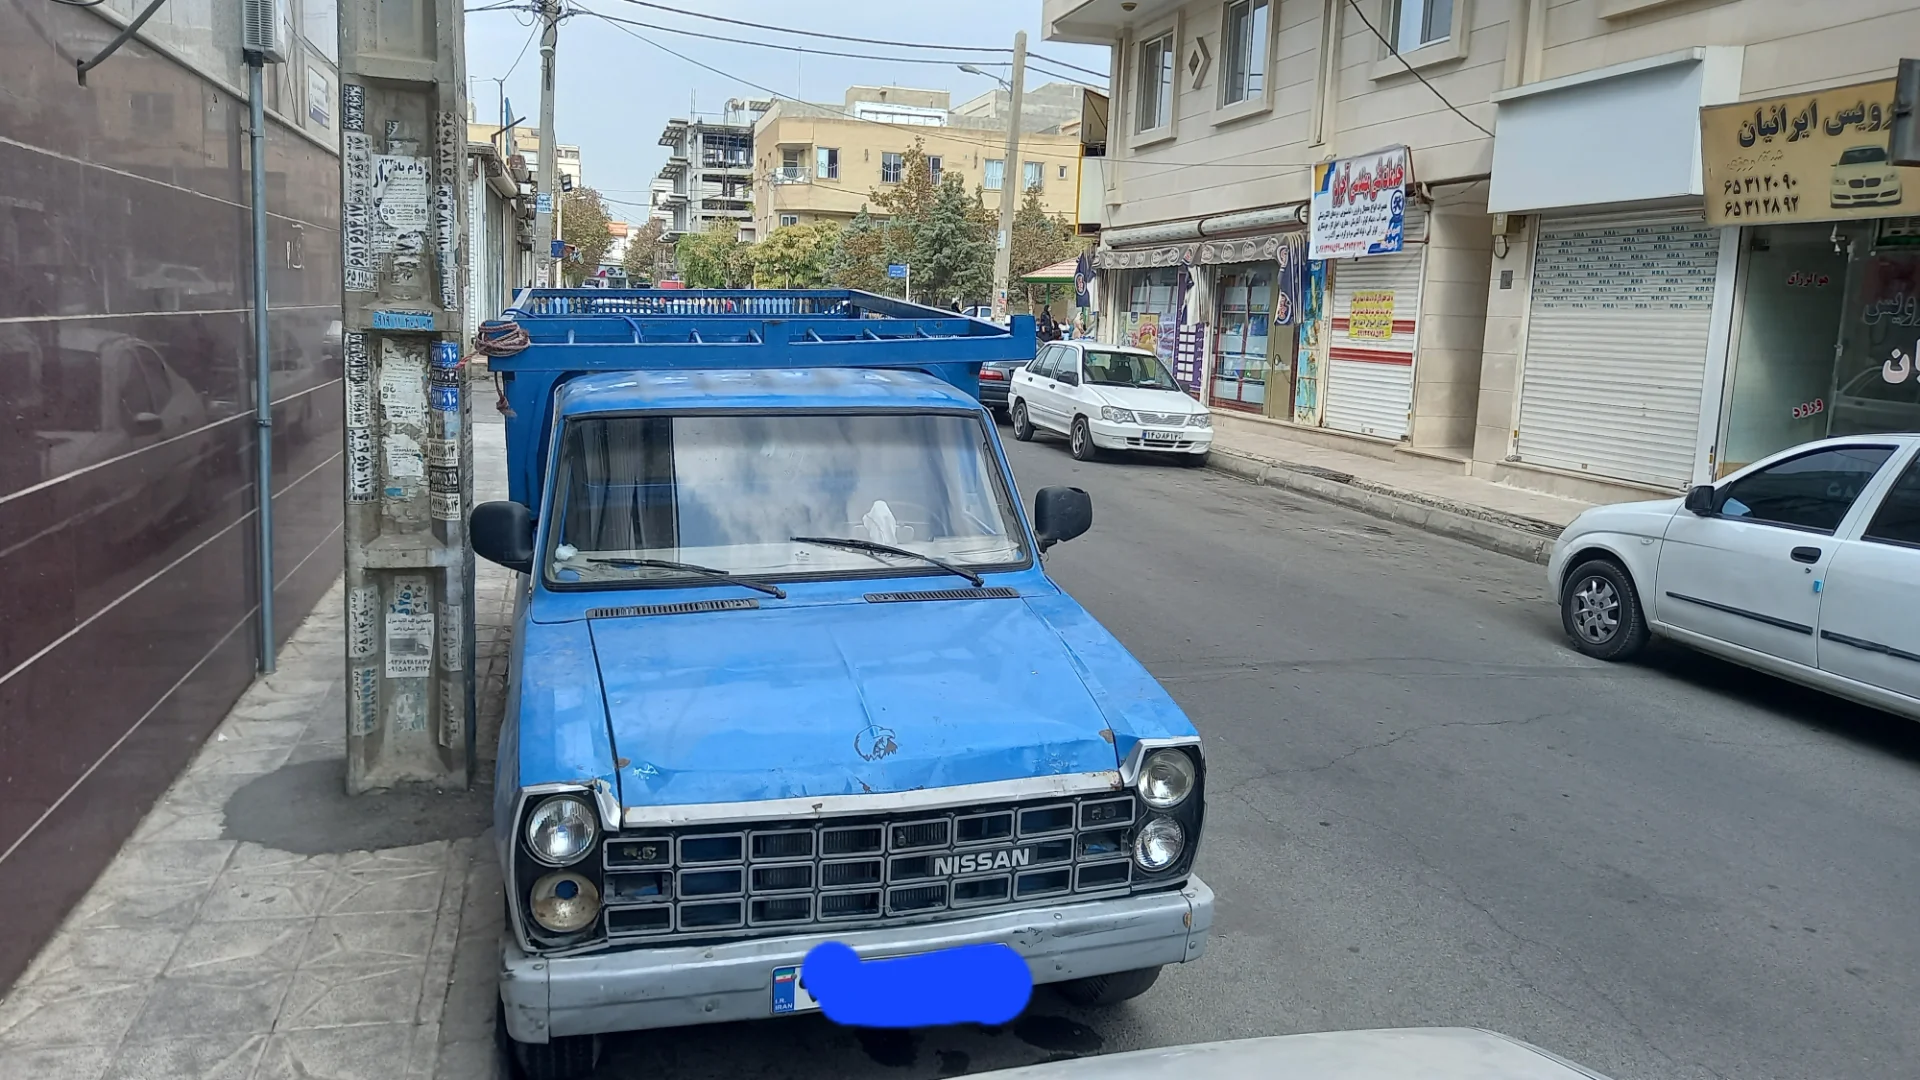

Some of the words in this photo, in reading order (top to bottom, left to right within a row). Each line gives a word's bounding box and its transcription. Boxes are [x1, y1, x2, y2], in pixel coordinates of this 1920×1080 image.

[1737, 99, 1817, 147] ایرانیان
[1823, 100, 1893, 136] رویس
[352, 138, 364, 150] ۱۷
[352, 156, 364, 178] ۶۵۴
[407, 162, 423, 175] وام
[352, 184, 364, 204] ۶۵۱
[437, 232, 448, 250] ۰۹۱۰
[350, 247, 364, 266] ۶۵۱
[374, 315, 390, 326] ۰۹۱۹
[1792, 398, 1823, 419] ورود
[356, 430, 369, 440] ۵۰
[356, 443, 369, 452] ۵۰
[356, 456, 369, 472] ۹۹۶
[356, 474, 369, 492] ۰۹۱۰
[934, 848, 1030, 876] NISSAN
[774, 1003, 794, 1011] IRAN
